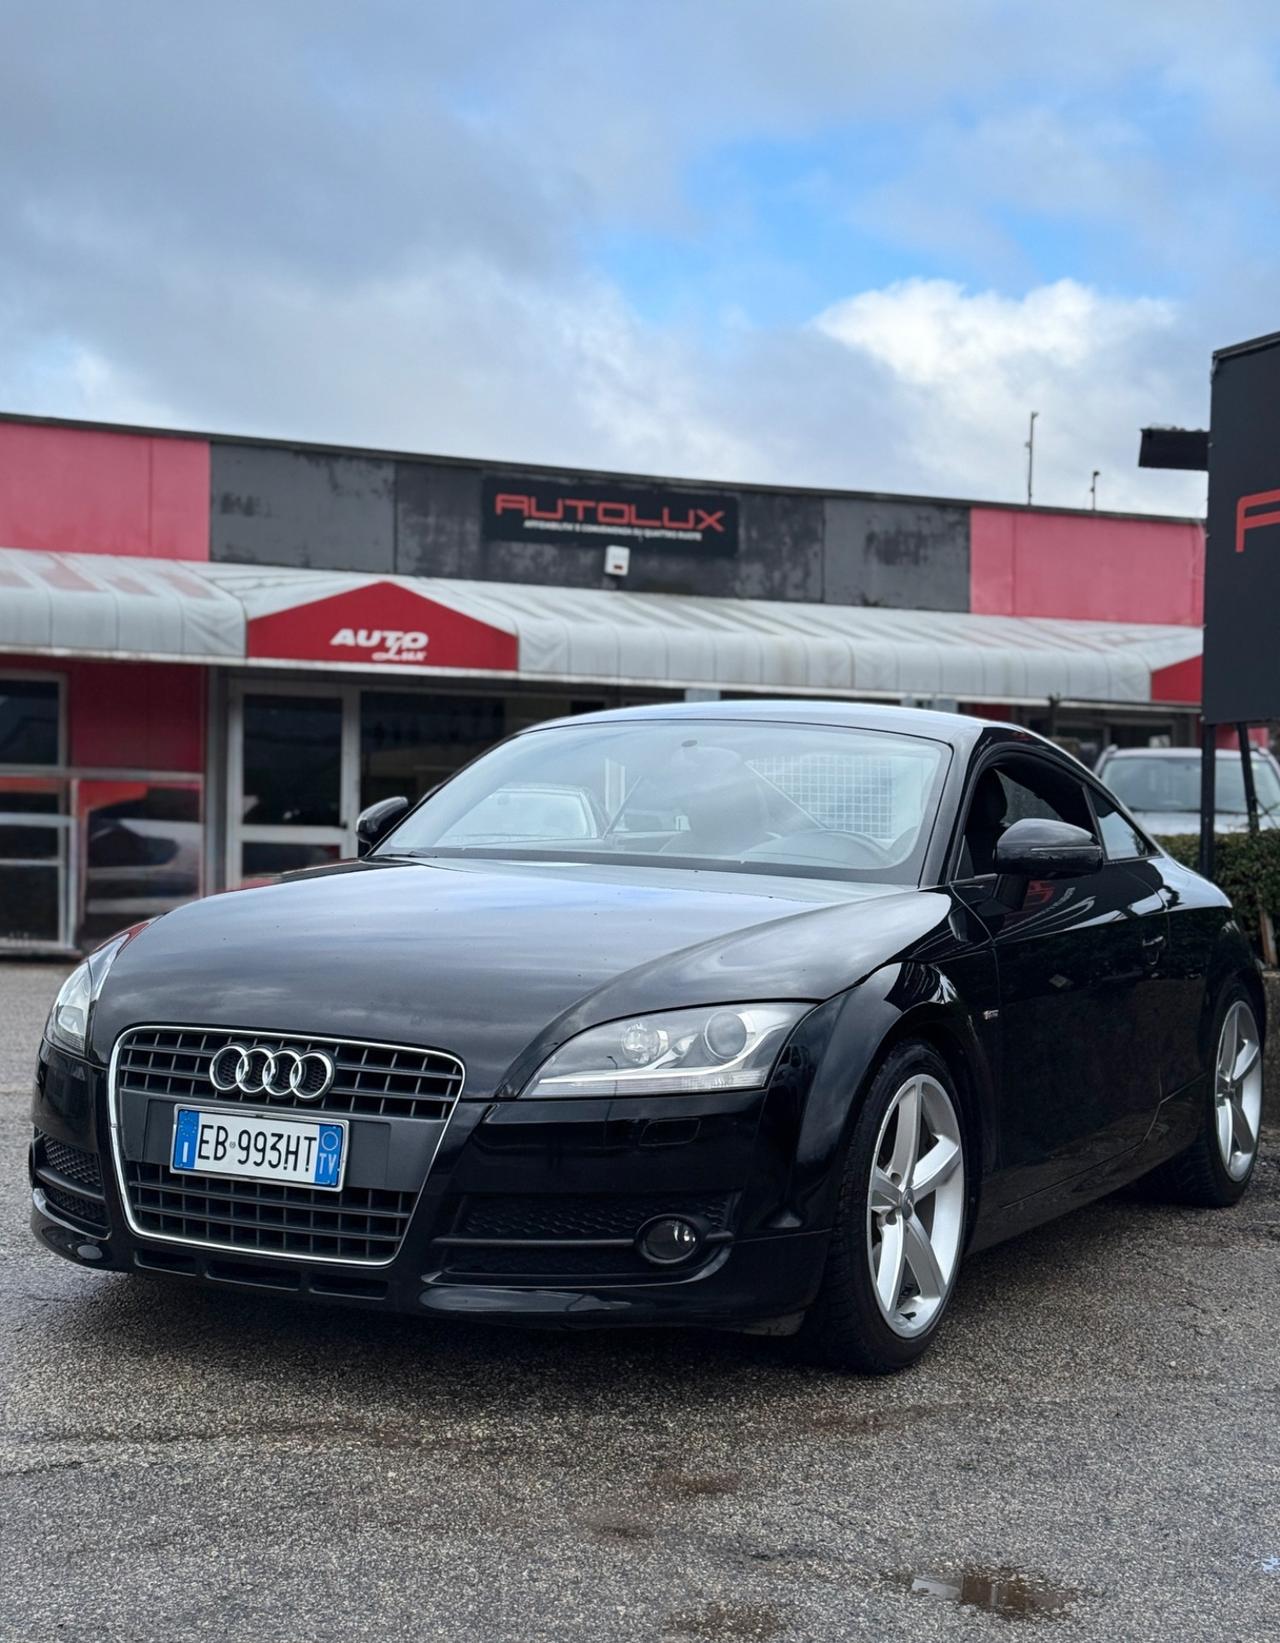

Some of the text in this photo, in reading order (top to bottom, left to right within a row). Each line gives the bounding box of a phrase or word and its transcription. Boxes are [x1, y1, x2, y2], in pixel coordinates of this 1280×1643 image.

[495, 493, 725, 532] AUTOLUX
[329, 627, 429, 650] AUTO
[318, 1152, 337, 1175] TV
